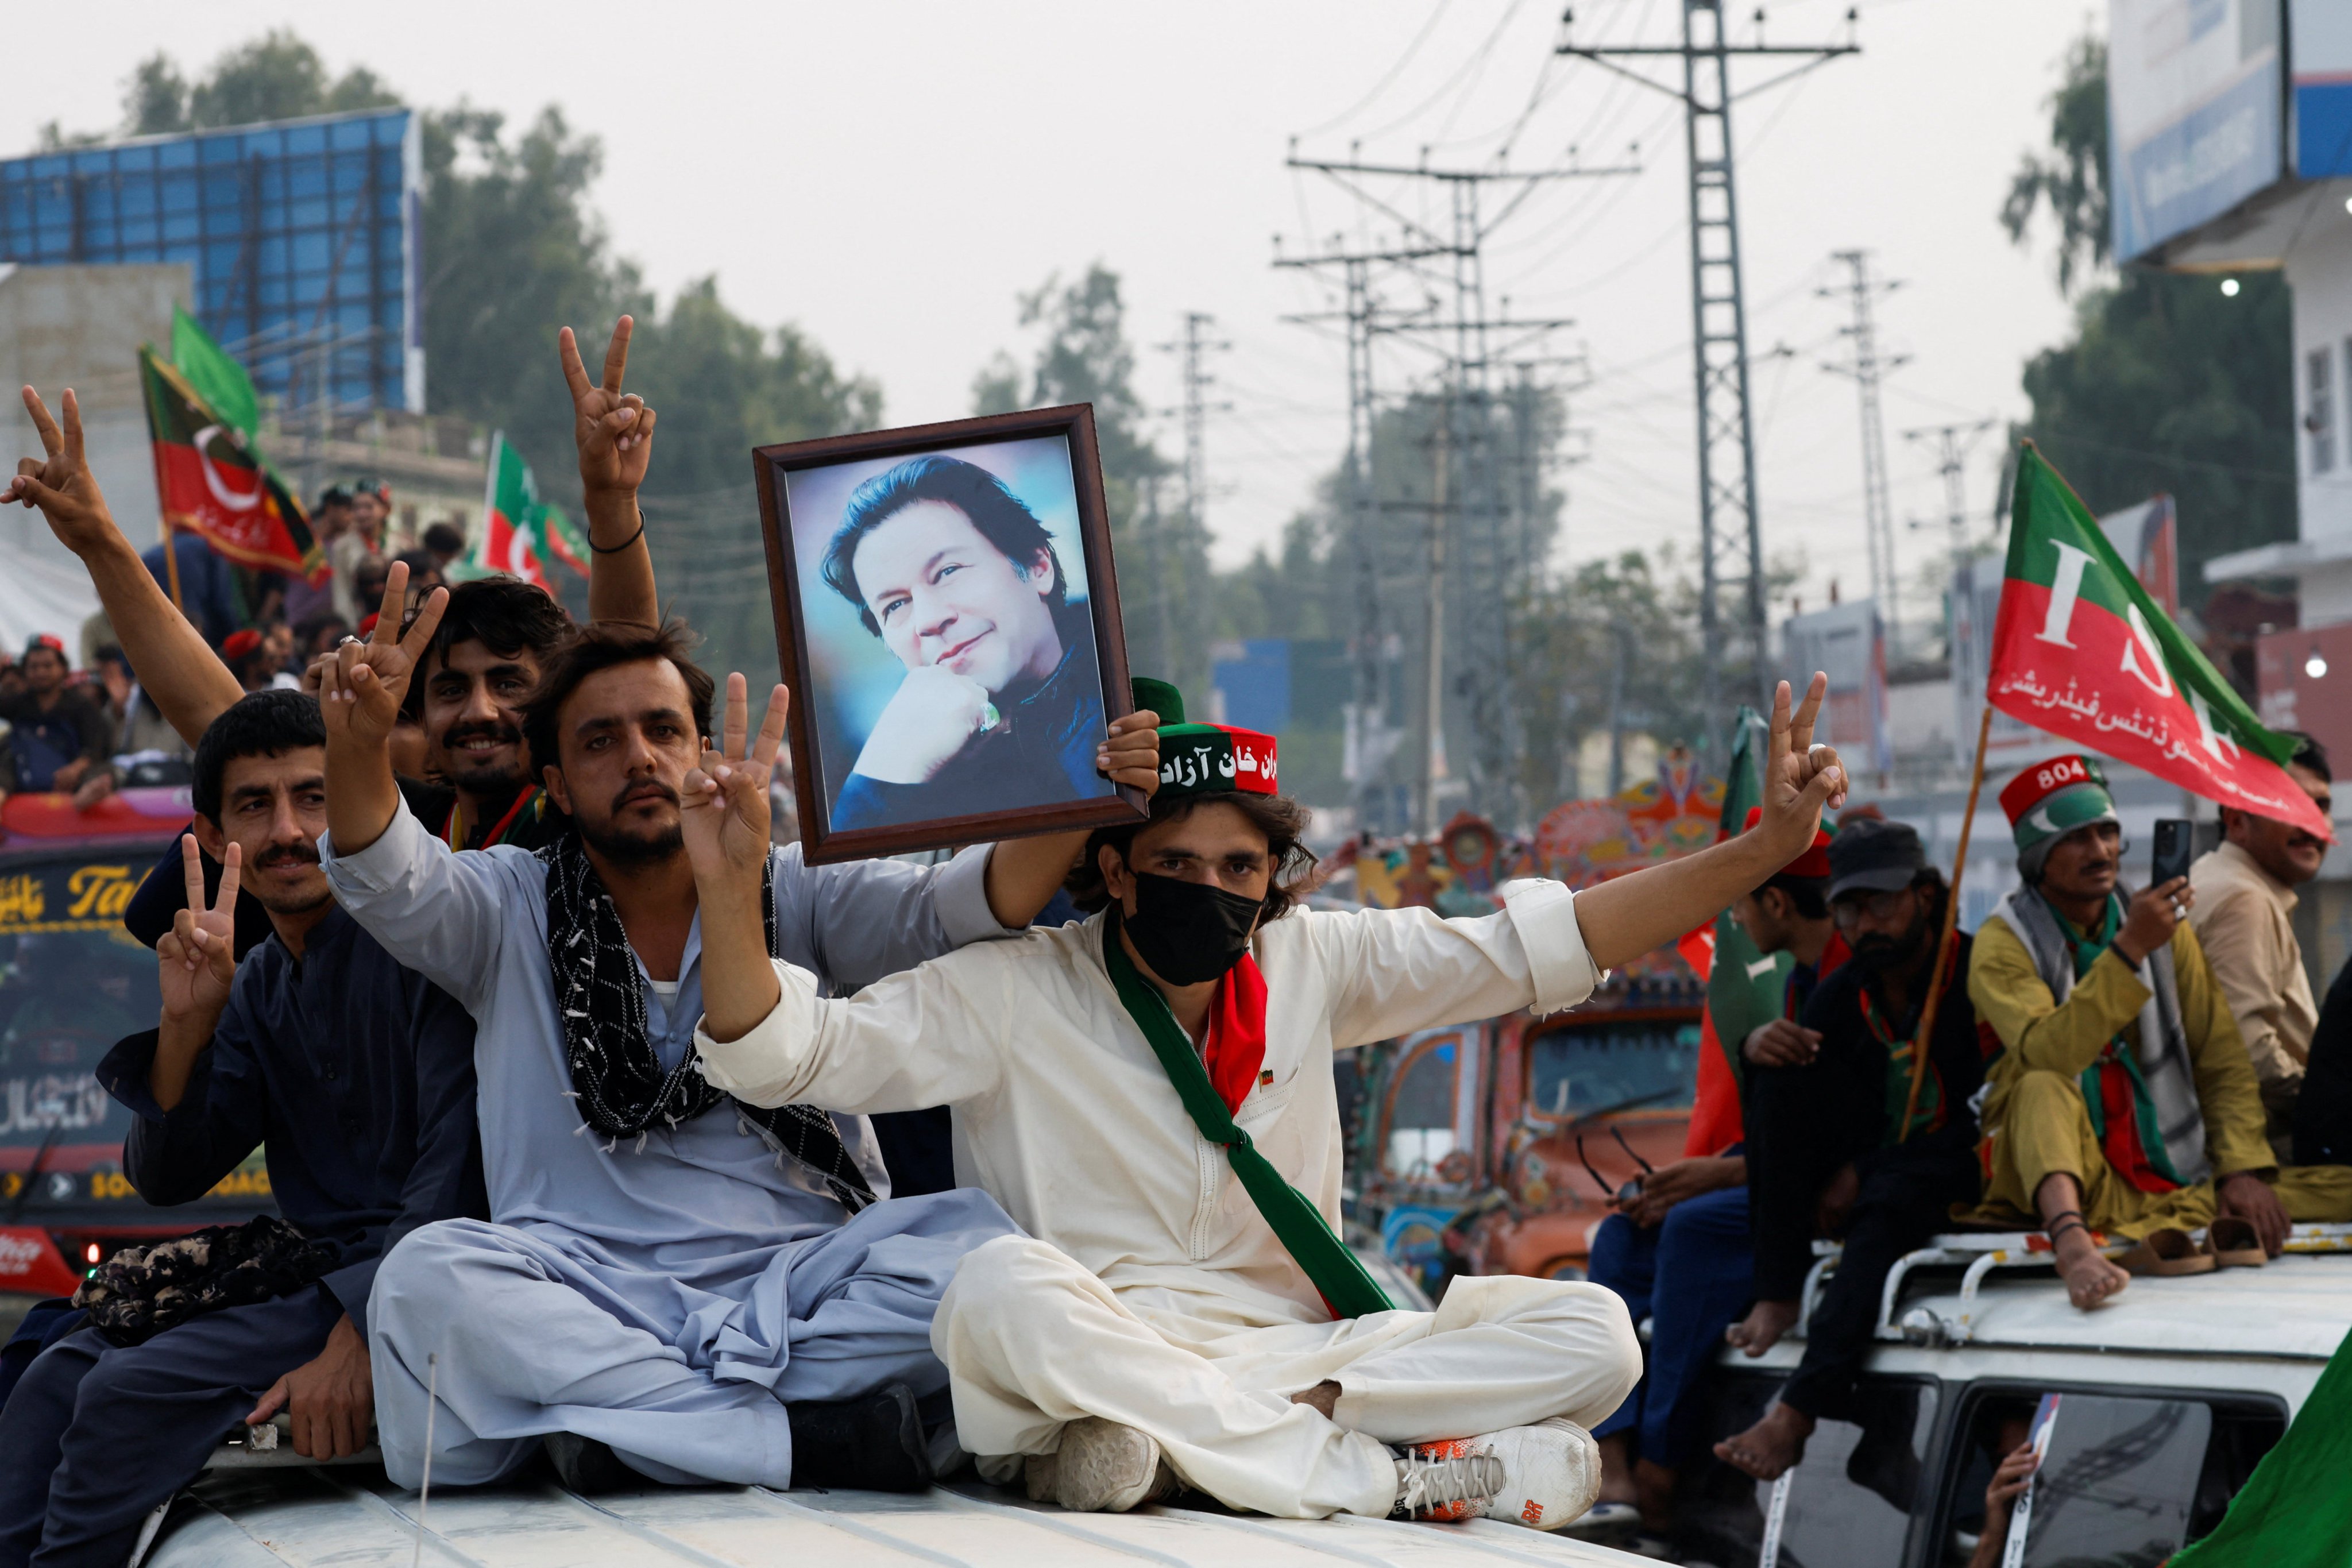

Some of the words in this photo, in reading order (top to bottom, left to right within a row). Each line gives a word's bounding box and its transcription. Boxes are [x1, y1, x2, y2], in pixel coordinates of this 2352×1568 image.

[1160, 746, 1212, 787] آزاد
[1218, 745, 1258, 778] خان
[2037, 759, 2086, 789] 804
